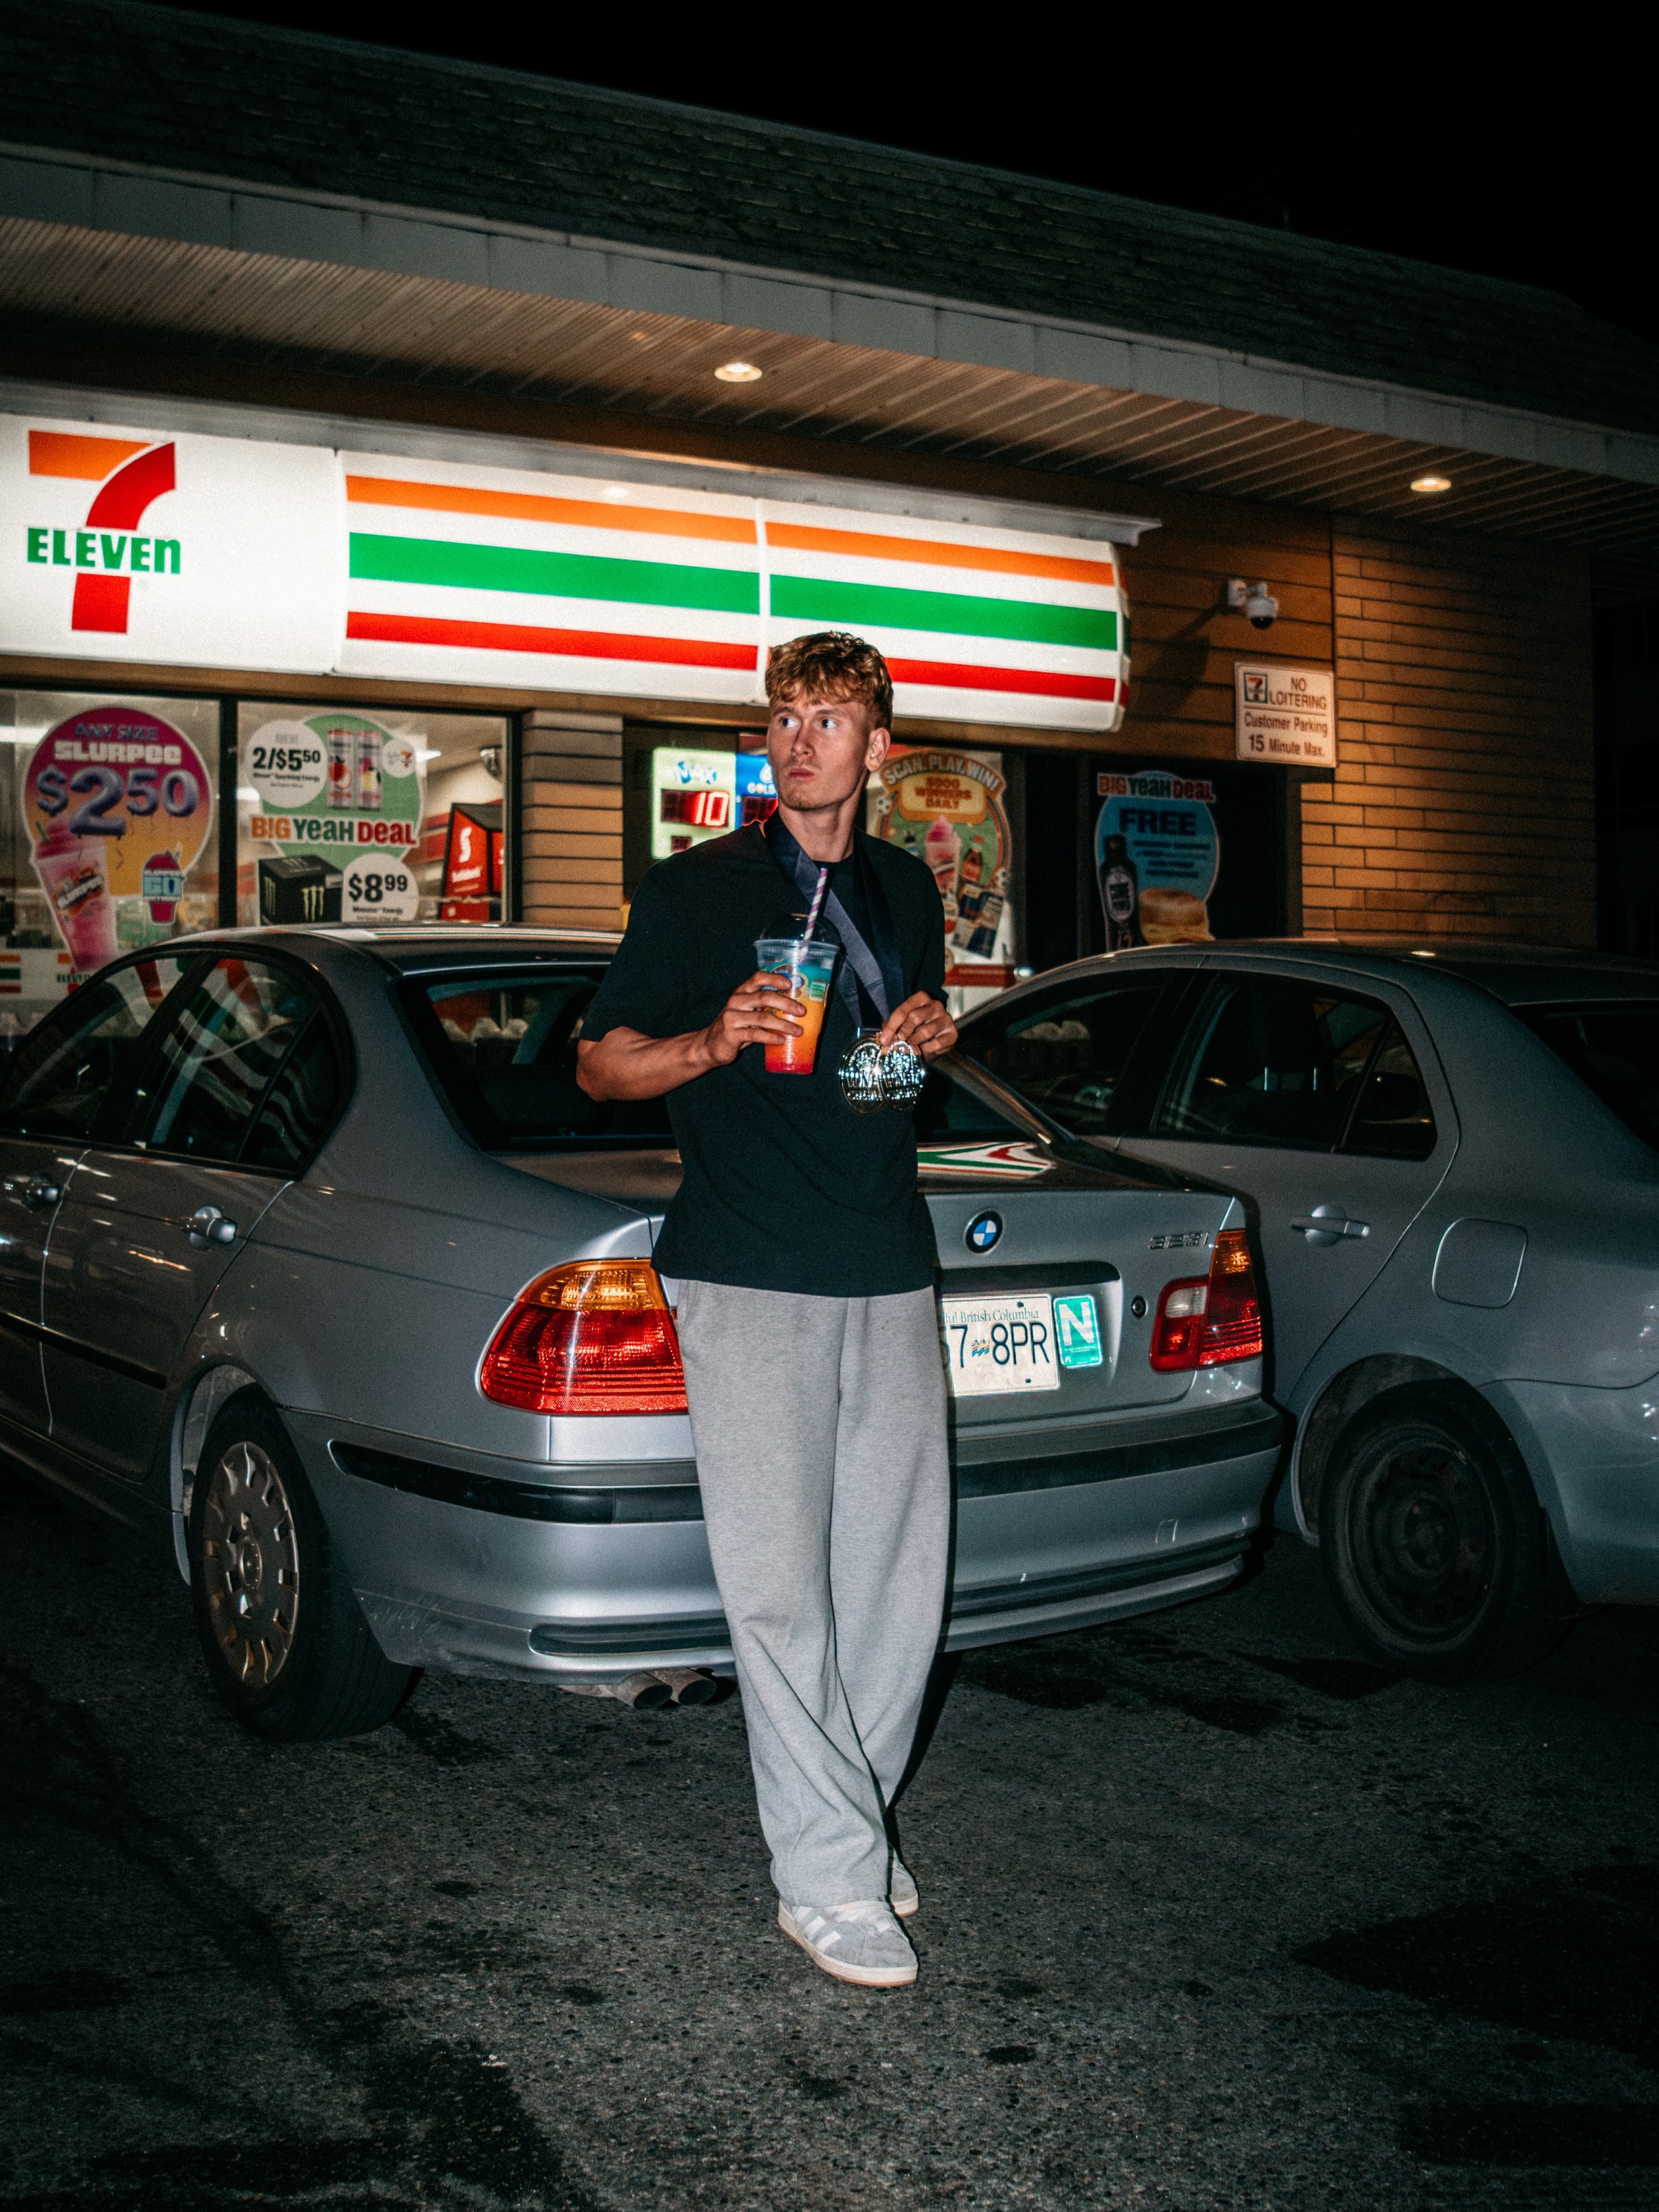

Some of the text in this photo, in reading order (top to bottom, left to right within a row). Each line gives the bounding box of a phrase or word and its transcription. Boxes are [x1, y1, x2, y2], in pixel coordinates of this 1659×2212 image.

[1291, 677, 1307, 692] NO
[1269, 691, 1327, 710] LOITERING
[74, 723, 159, 741] ANY SIZE
[1244, 711, 1327, 738] Customer Parking
[1248, 734, 1265, 752] 15
[1269, 738, 1301, 756] Minute
[694, 790, 729, 826] 10
[1119, 808, 1197, 836] FREE
[960, 1309, 991, 1323] British
[993, 1307, 1039, 1321] Columbia
[1058, 1301, 1095, 1347] N
